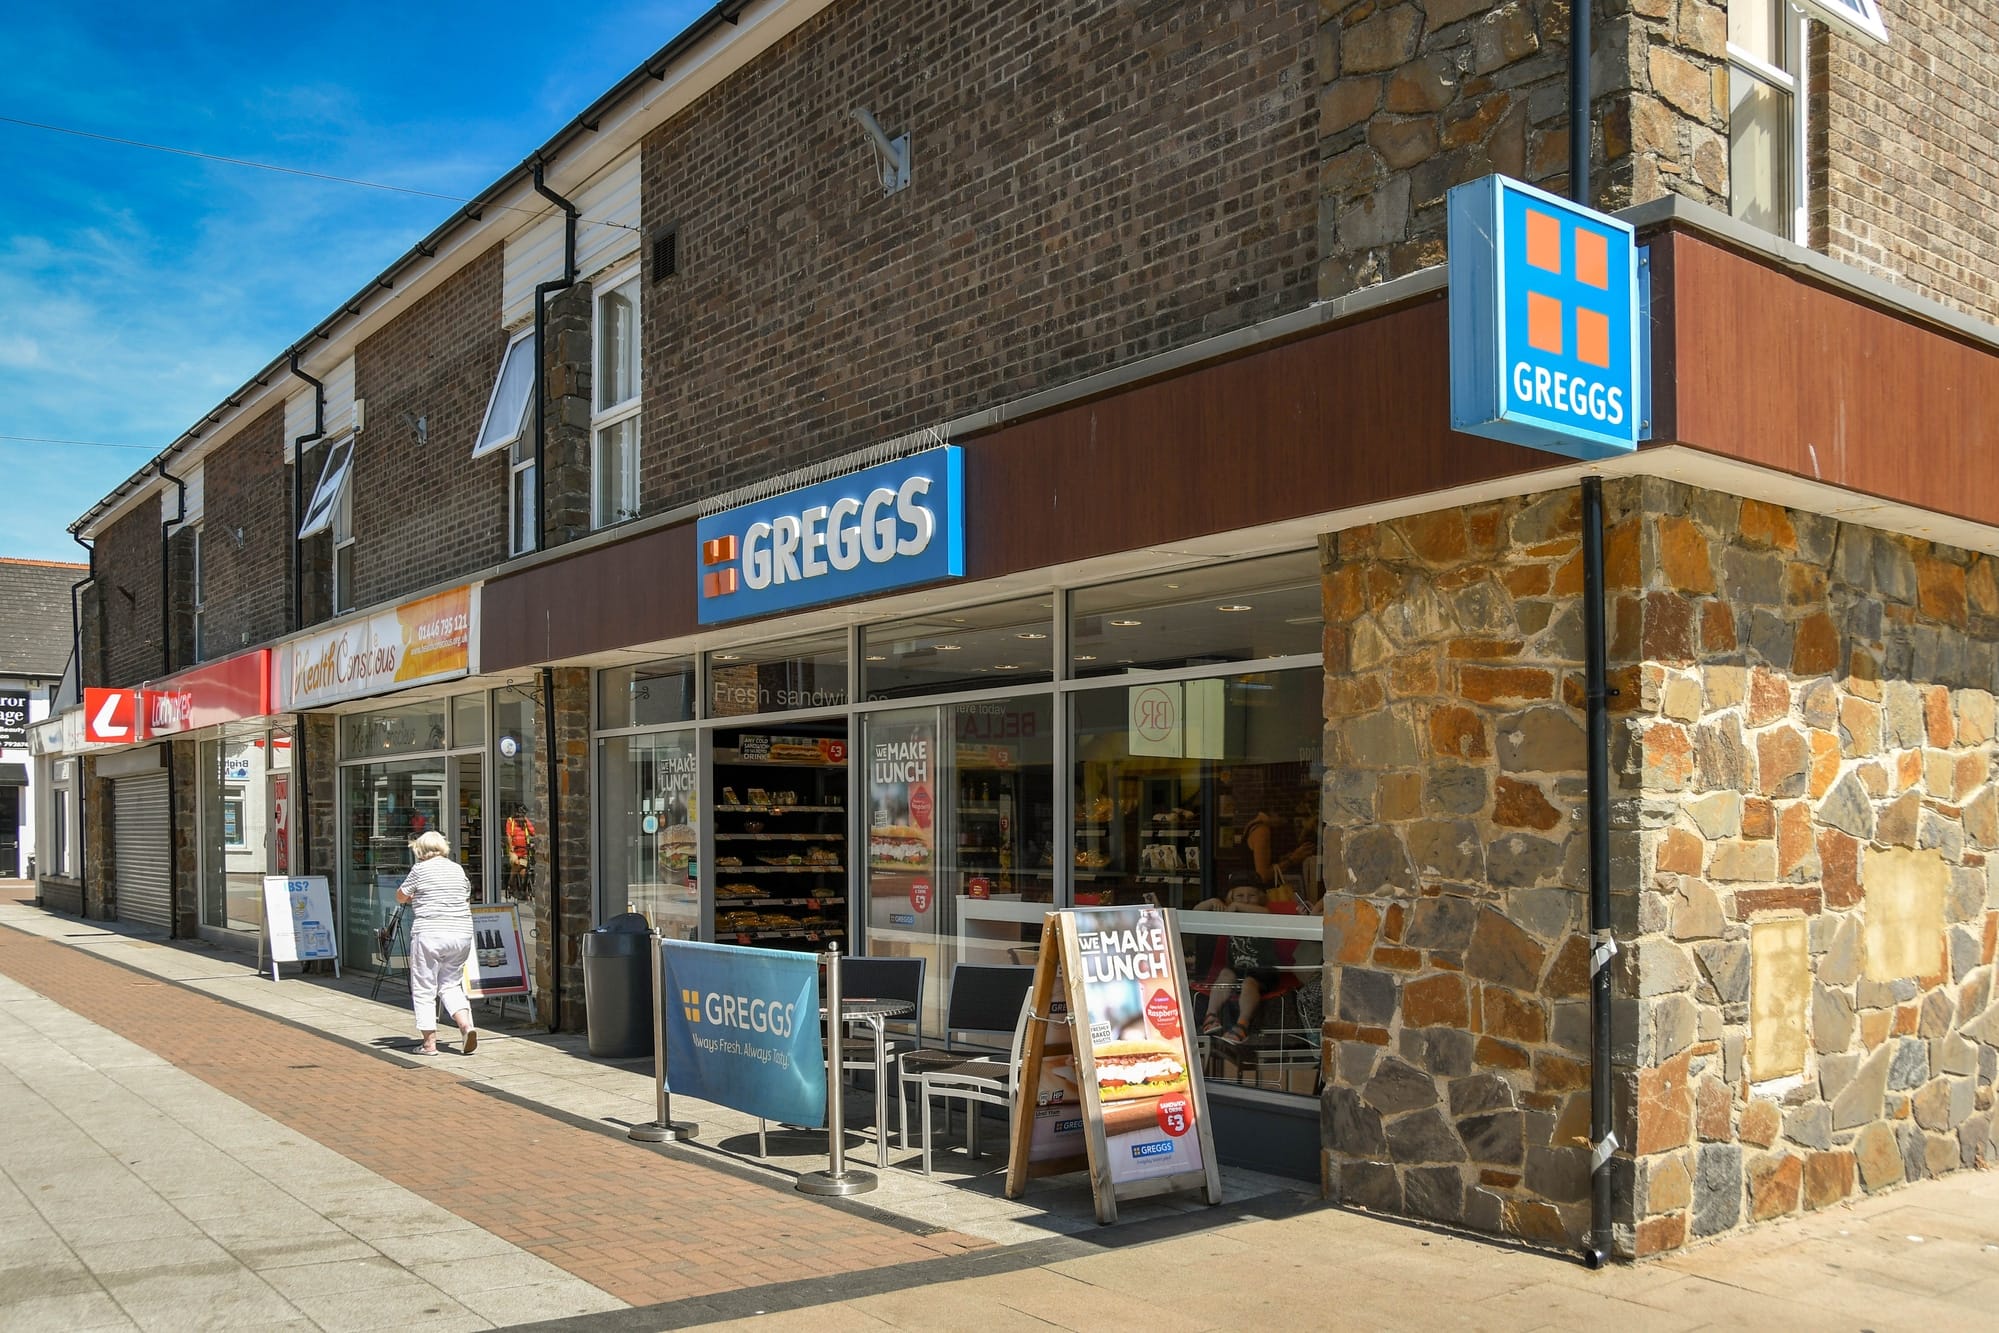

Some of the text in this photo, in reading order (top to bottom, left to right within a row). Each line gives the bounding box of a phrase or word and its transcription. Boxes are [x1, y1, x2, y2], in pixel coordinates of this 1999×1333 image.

[1513, 361, 1624, 425] GREGGS
[742, 476, 936, 590] GREGGS
[454, 612, 468, 631] 121
[294, 632, 396, 697] Health Conscious
[714, 681, 888, 707] Fresh sandwies
[830, 745, 842, 757] £3
[887, 741, 927, 761] MAKE
[669, 756, 696, 774] MAKE
[875, 761, 927, 784] LUNCH
[660, 773, 696, 792] LUNCH
[915, 895, 926, 909] £3
[1079, 929, 1165, 954] WE MAKE
[1081, 952, 1169, 984] LUNCH
[705, 992, 794, 1038] GREGGS
[743, 1043, 772, 1065] Always
[1167, 1114, 1185, 1132] £3
[1141, 1142, 1172, 1155] GREGGS
